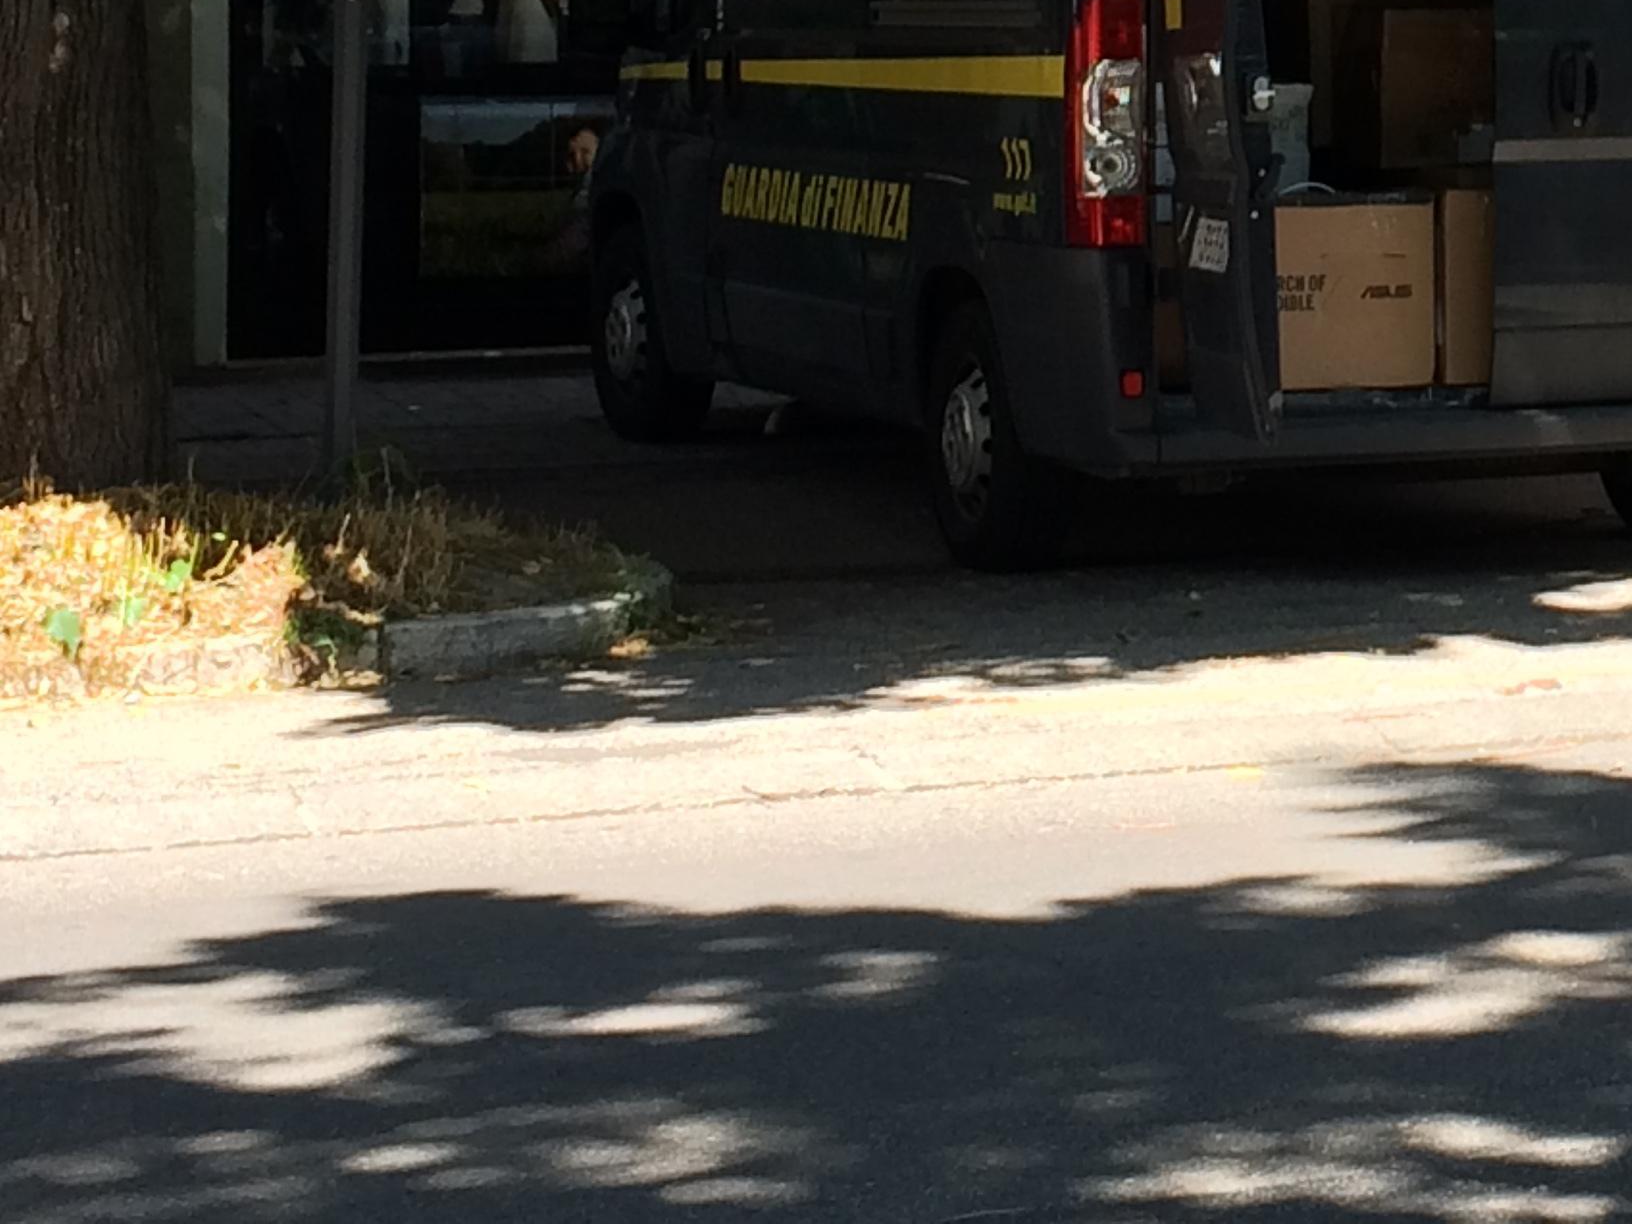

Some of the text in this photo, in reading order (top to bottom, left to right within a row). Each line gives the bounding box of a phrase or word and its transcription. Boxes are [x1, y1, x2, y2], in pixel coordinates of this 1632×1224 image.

[1000, 136, 1032, 181] 117
[720, 161, 912, 241] GUARDIA di FINANZA
[1359, 283, 1414, 300] ASUS
